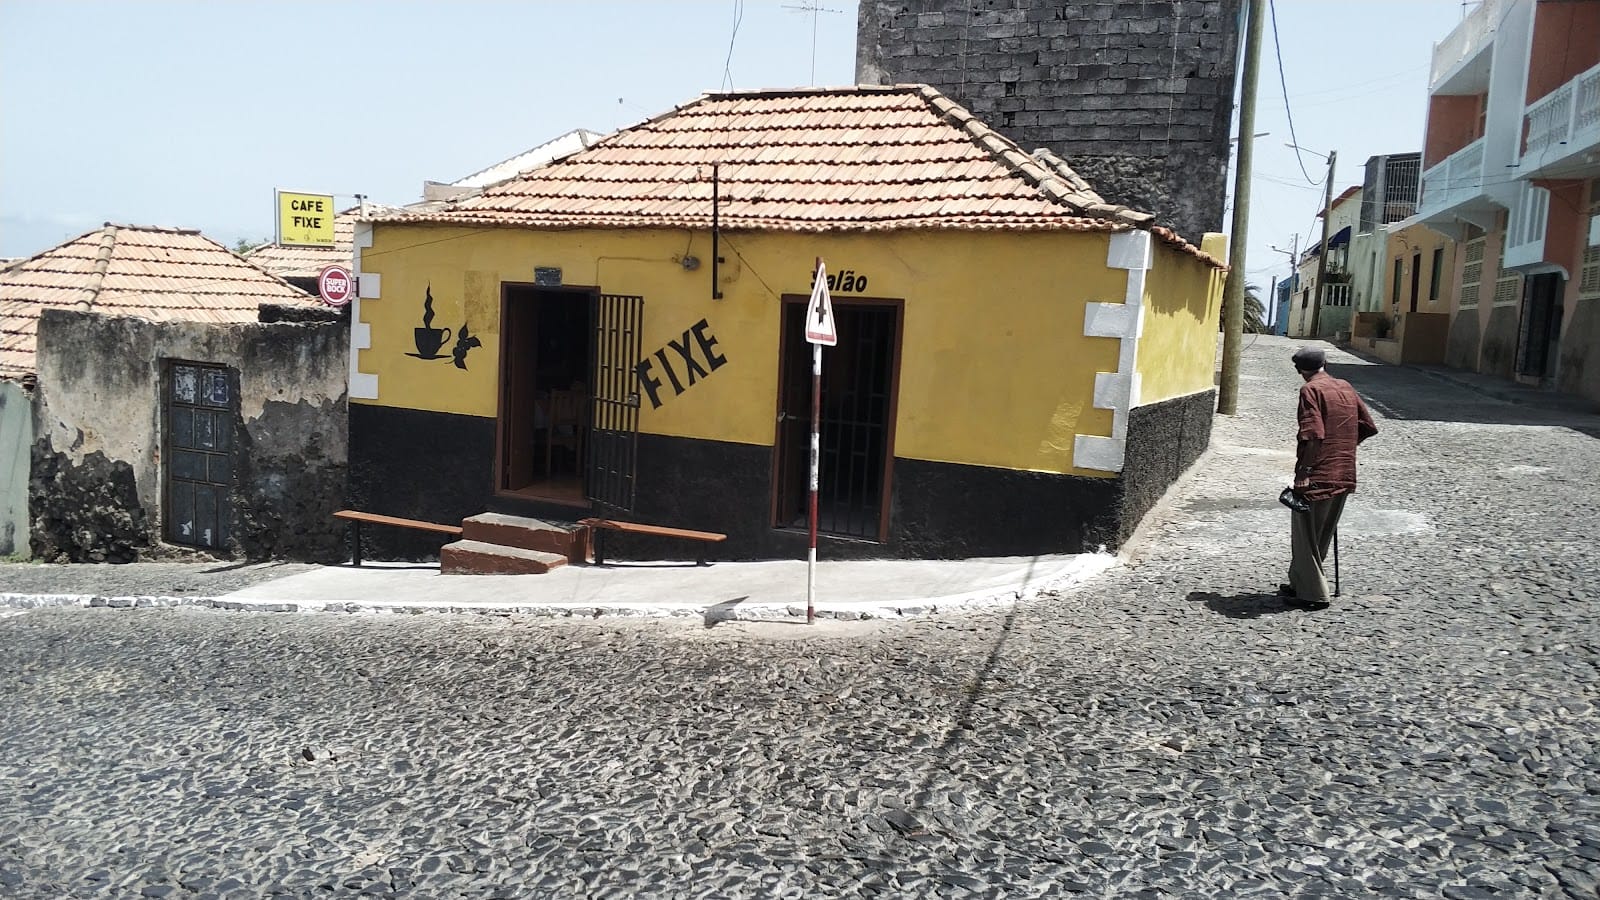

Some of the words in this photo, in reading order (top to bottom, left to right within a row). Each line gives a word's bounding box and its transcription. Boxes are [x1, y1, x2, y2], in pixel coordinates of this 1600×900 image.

[294, 216, 322, 229] FIXE
[326, 277, 347, 287] SUPER
[326, 285, 346, 294] BOCK
[635, 318, 728, 411] FIXE
